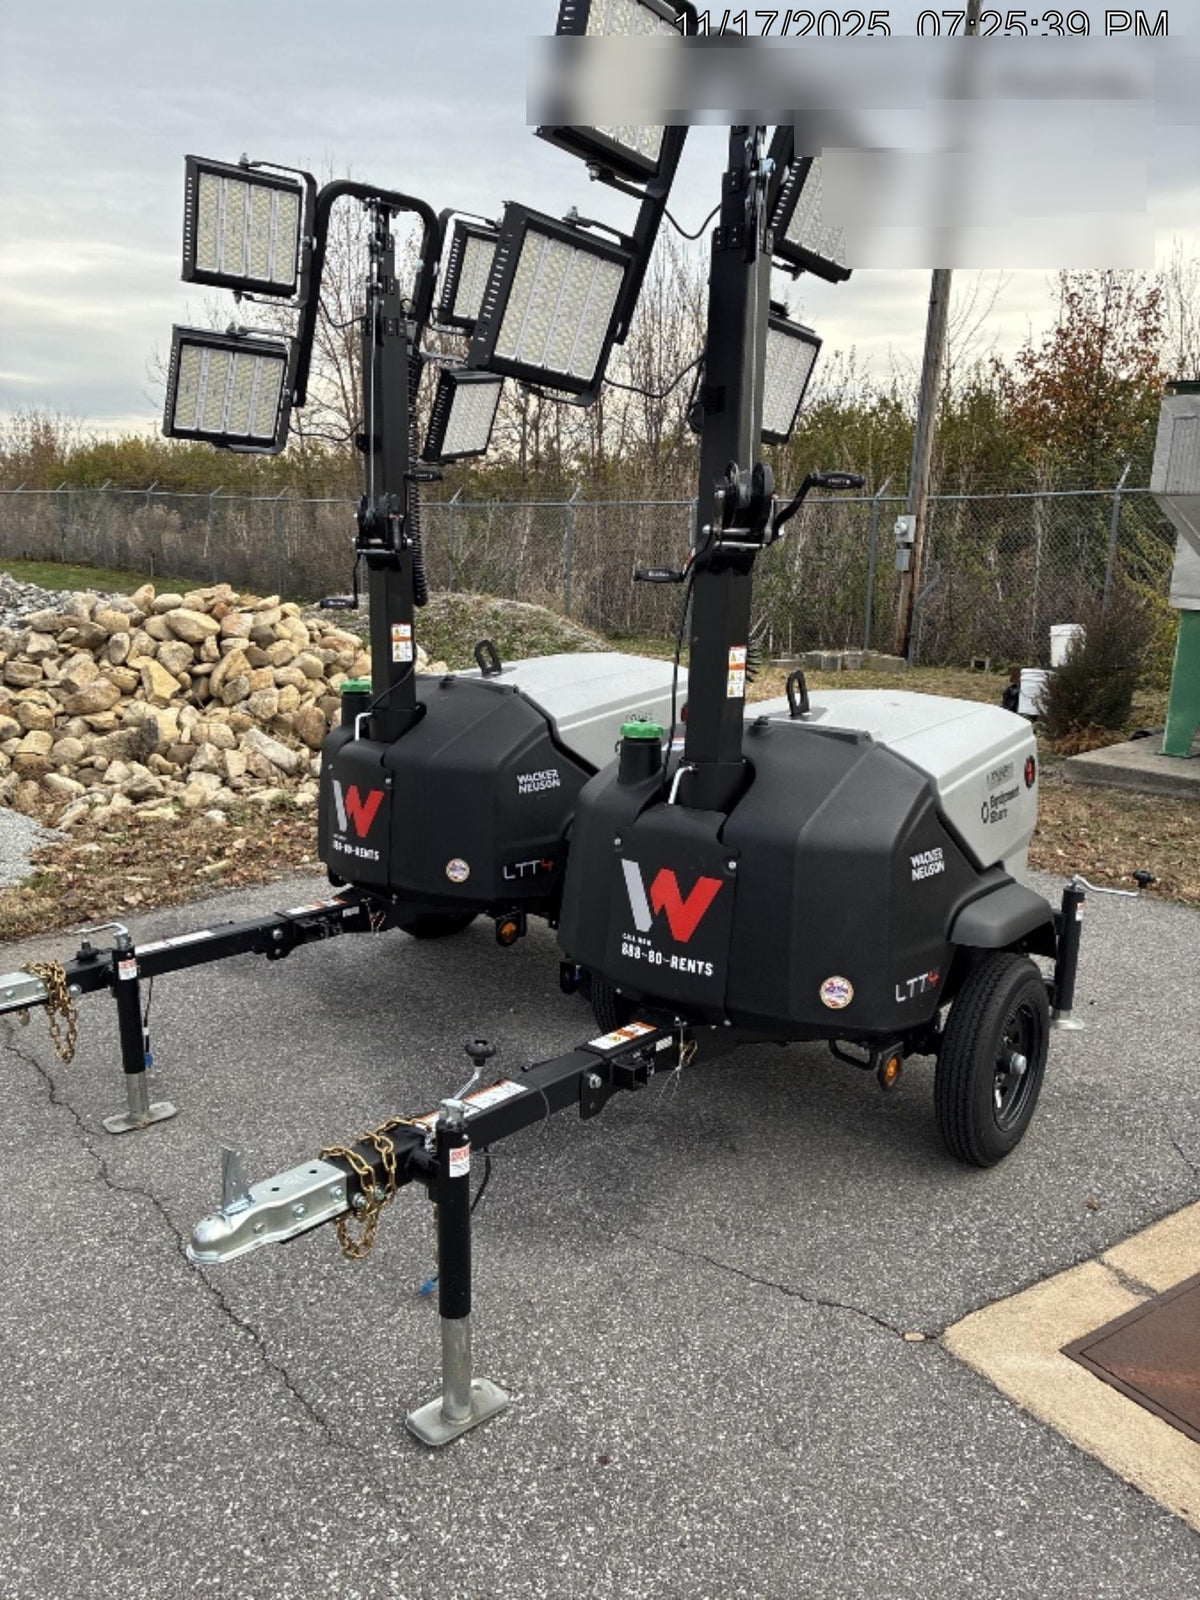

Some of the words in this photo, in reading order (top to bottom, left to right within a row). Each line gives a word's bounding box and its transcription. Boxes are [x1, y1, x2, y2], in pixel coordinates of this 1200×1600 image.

[516, 769, 559, 784] WACKER
[518, 778, 561, 794] NEUSON
[910, 847, 943, 868] WACKER
[503, 859, 554, 880] LTT4
[911, 859, 945, 882] NEUSON
[621, 941, 714, 977] 888-80-RENTS
[895, 970, 940, 1003] LTT4
